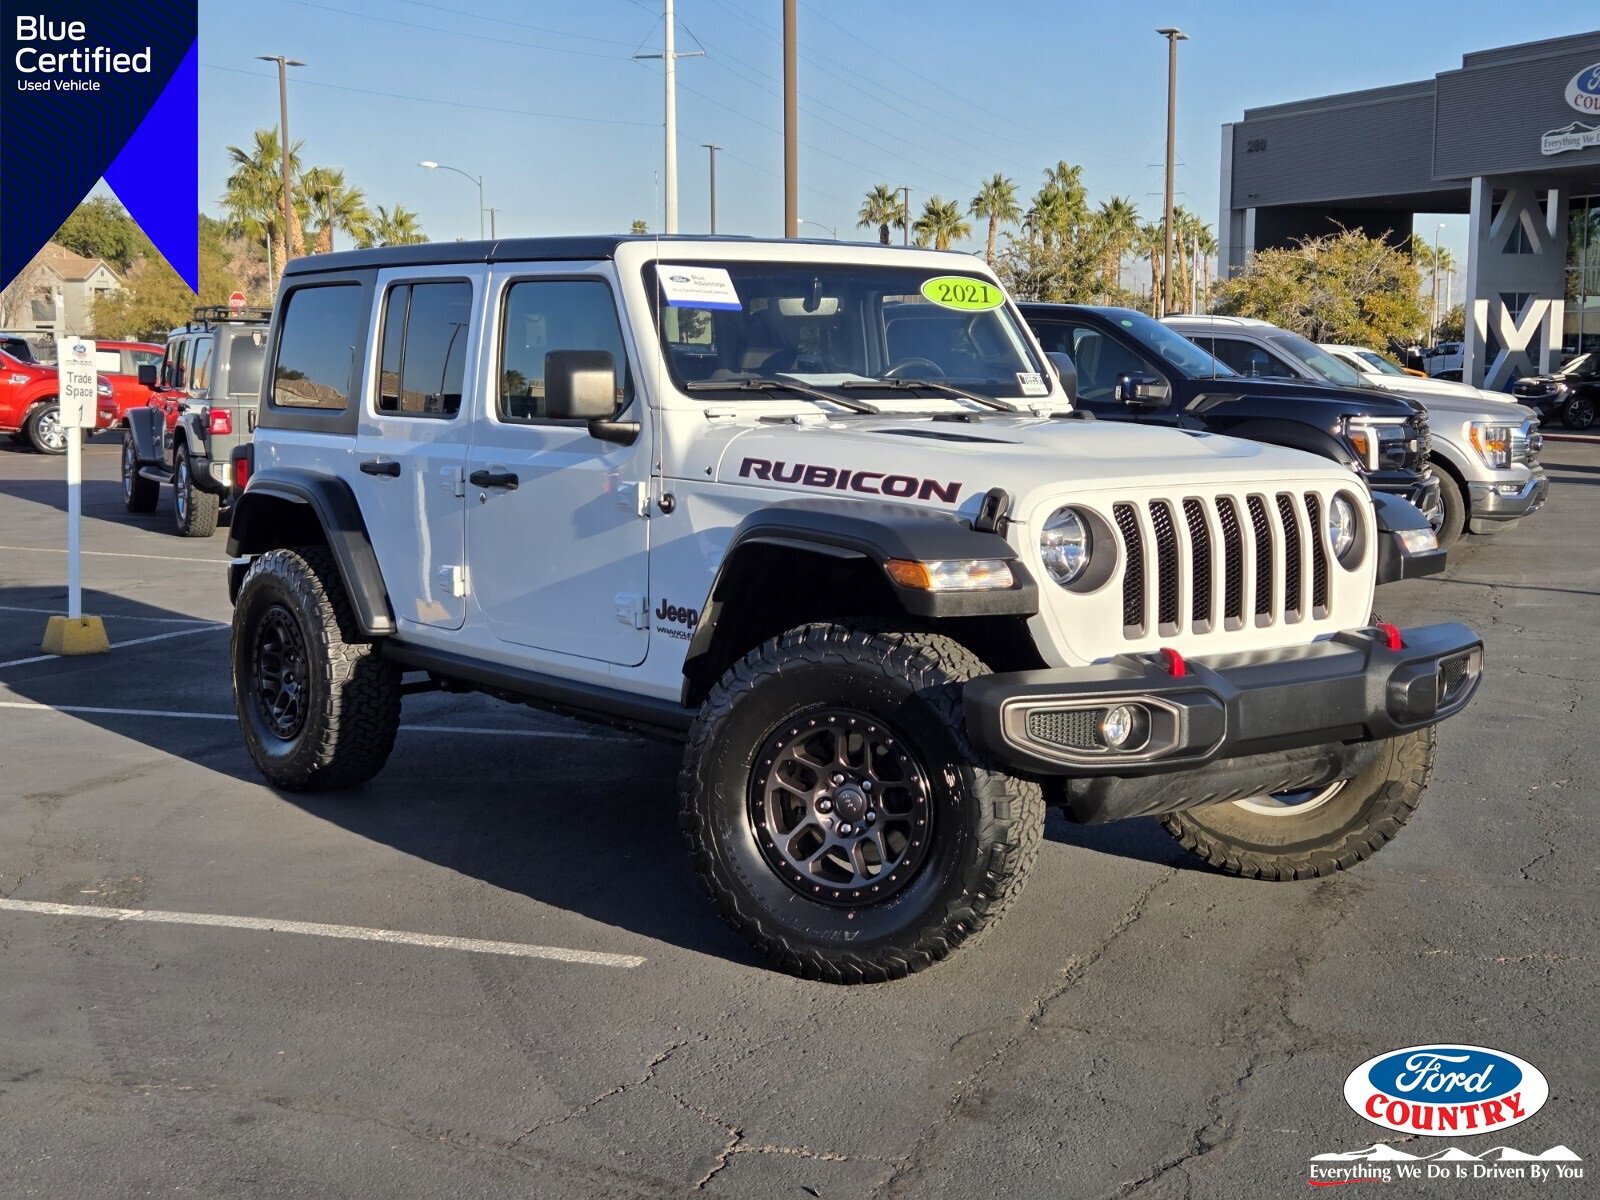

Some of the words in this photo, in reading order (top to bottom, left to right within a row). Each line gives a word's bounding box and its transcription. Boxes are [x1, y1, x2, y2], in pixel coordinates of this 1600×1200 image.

[1544, 135, 1581, 148] Everything
[1583, 134, 1594, 143] We
[938, 284, 991, 303] 2021
[67, 371, 92, 384] Trade
[66, 384, 93, 398] Space
[78, 404, 84, 421] 1
[738, 457, 963, 504] RUBICON
[655, 598, 698, 629] Jeep
[656, 626, 694, 638] WRANGLE
